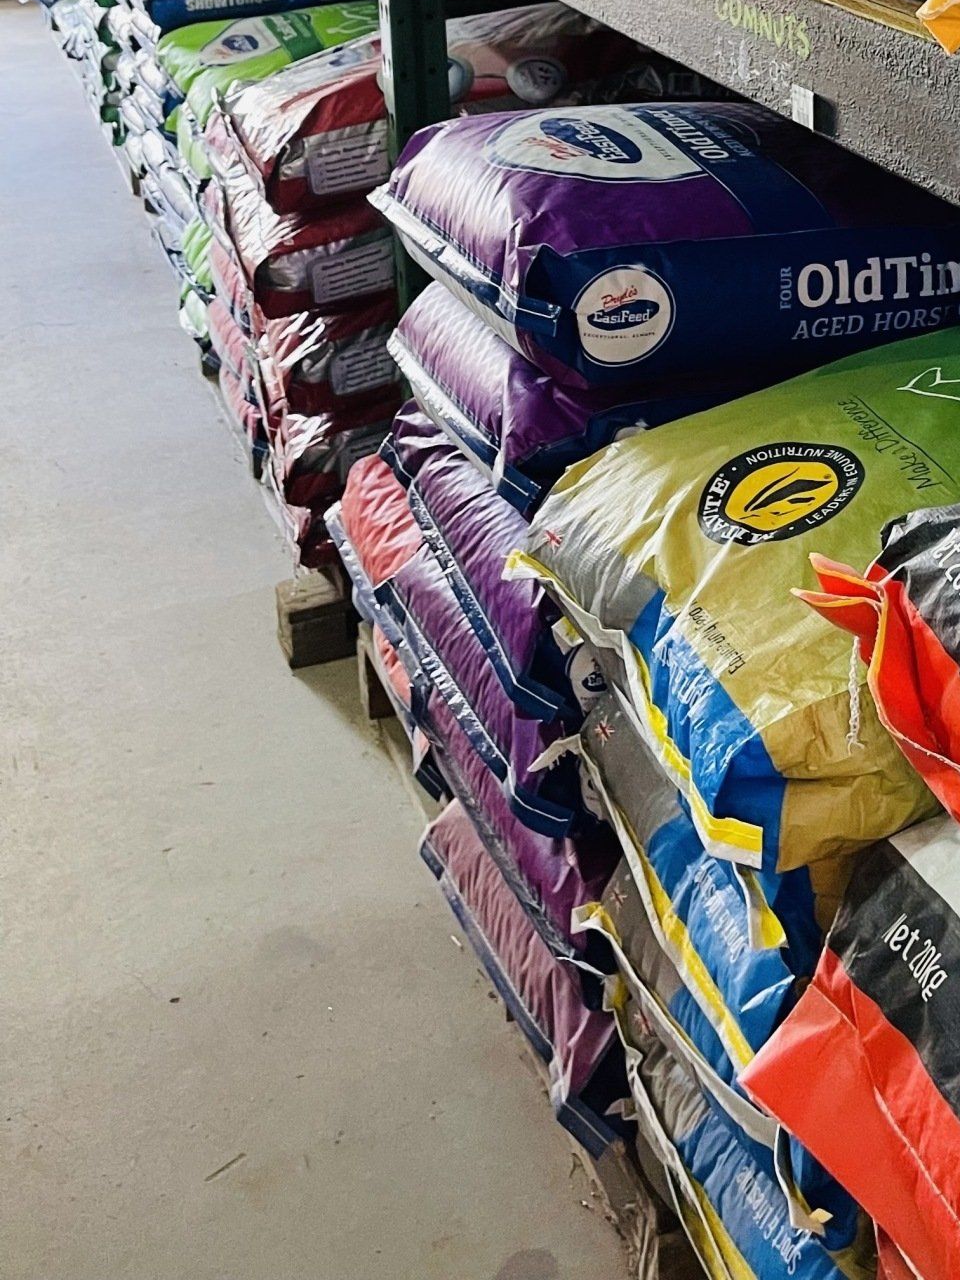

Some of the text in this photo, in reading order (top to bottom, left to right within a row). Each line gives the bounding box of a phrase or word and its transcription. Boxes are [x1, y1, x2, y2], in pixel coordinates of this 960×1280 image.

[779, 266, 792, 310] FOUR
[592, 308, 651, 324] EasiFeed
[792, 314, 863, 340] AGED
[745, 445, 825, 467] NUTRITION
[824, 448, 859, 478] EQUINE
[805, 485, 854, 525] LEADERS
[909, 939, 948, 1003] 20kg
